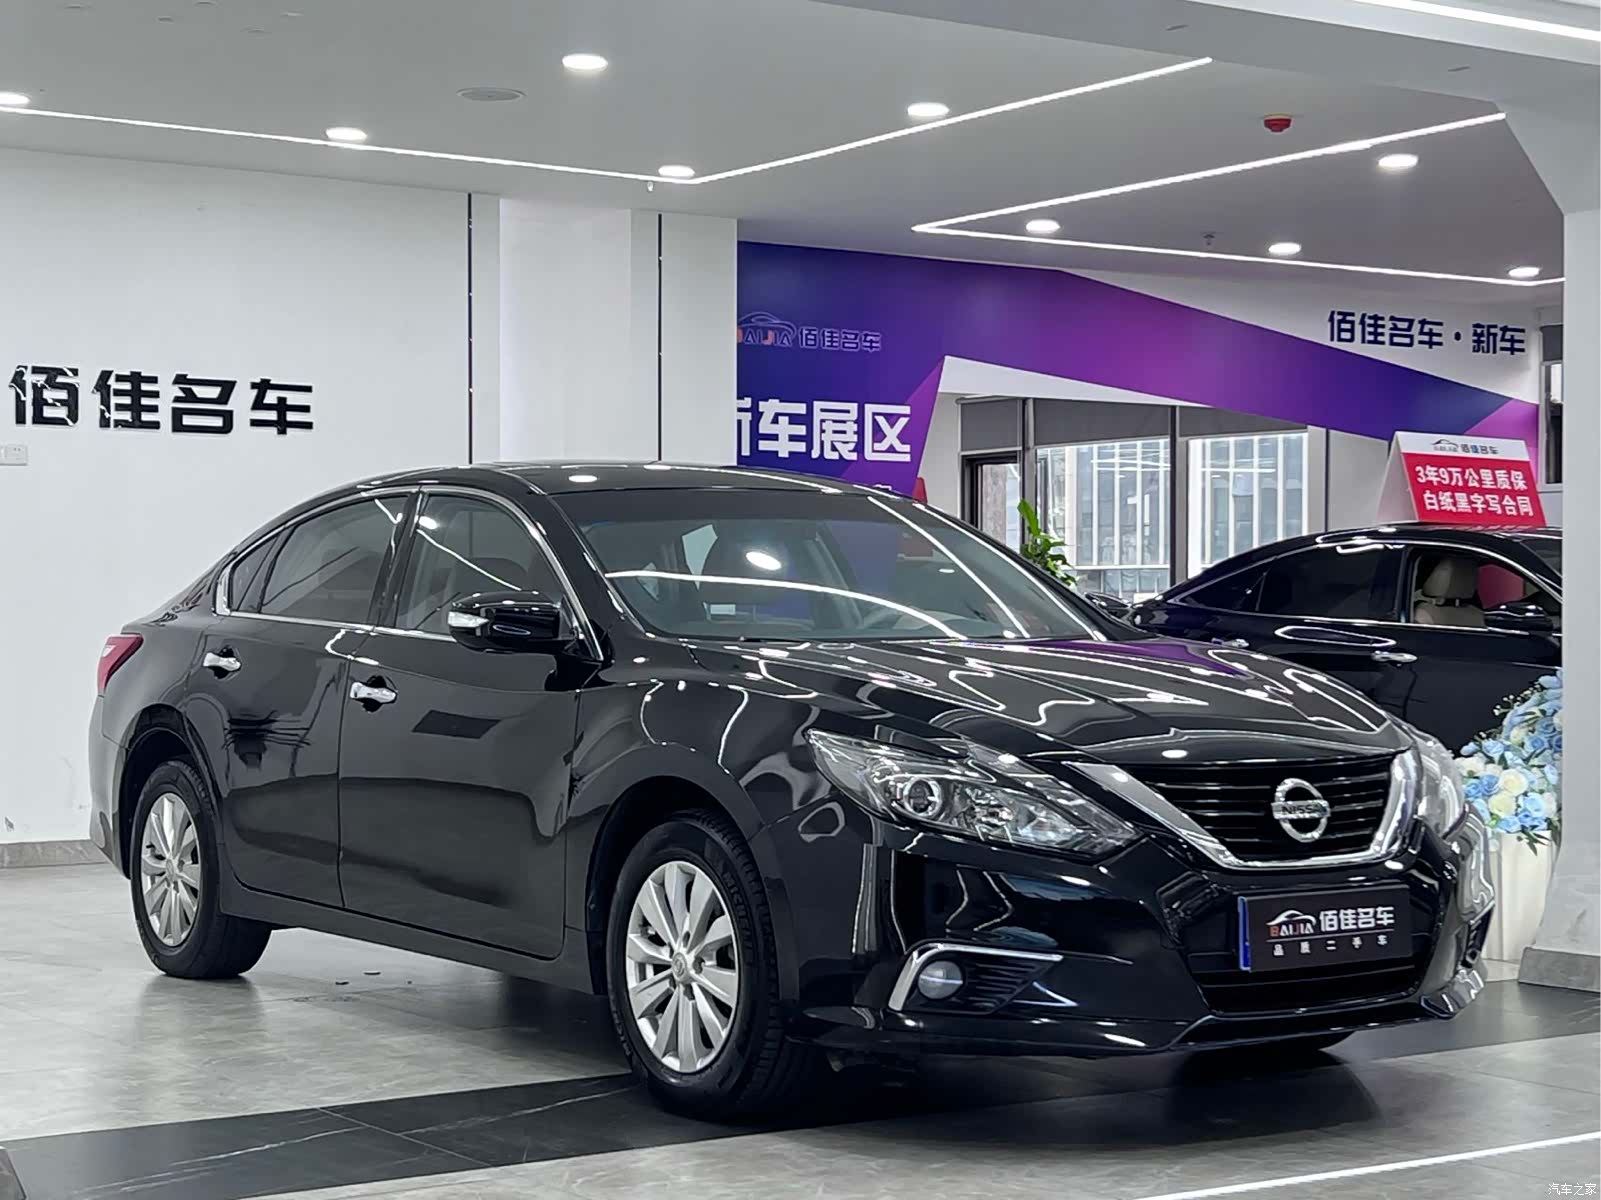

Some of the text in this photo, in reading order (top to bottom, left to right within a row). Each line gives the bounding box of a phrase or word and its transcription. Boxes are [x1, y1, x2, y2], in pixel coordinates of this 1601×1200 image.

[799, 326, 881, 352] 佰佳名车
[1327, 309, 1526, 356] 佰佳名车·新车
[8, 364, 314, 436] 佰佳名车
[1415, 465, 1527, 490] 3年9万公里质保
[1423, 490, 1534, 517] 白纸黑字写合同
[1270, 906, 1395, 937] BAIJIA 佰佳名车
